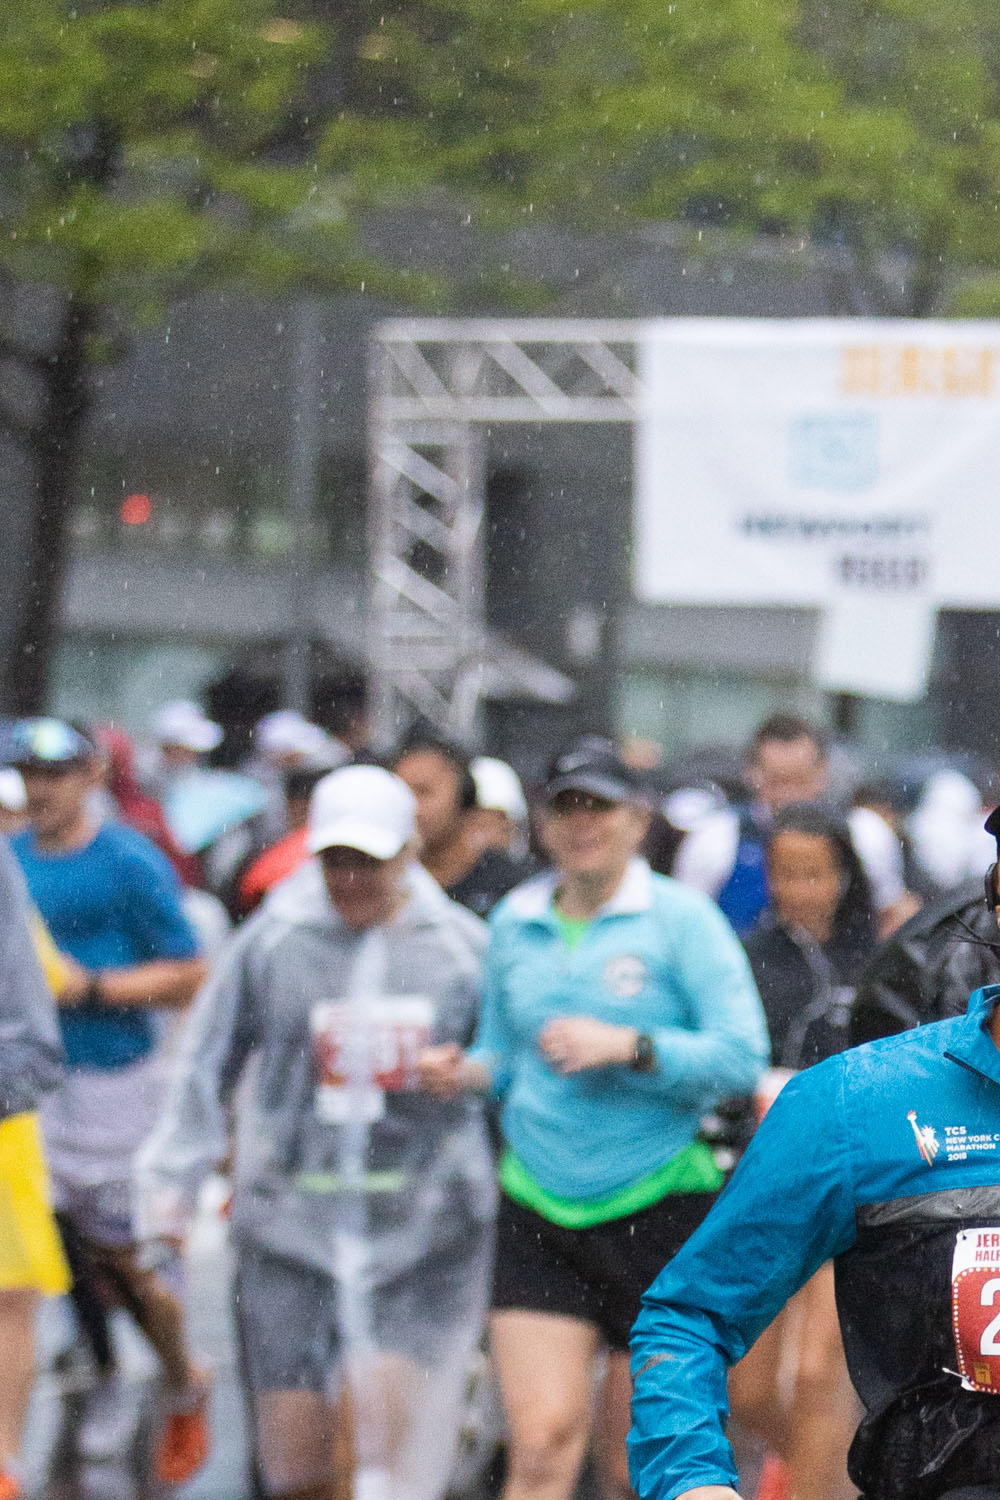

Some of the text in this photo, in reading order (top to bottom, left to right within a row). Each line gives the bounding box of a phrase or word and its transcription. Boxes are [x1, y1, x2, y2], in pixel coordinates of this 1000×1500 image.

[944, 1125, 967, 1136] TCS
[945, 1135, 967, 1145] NEW
[968, 1134, 992, 1143] YORK
[946, 1142, 996, 1152] MARATHON
[975, 1250, 1000, 1262] HALF
